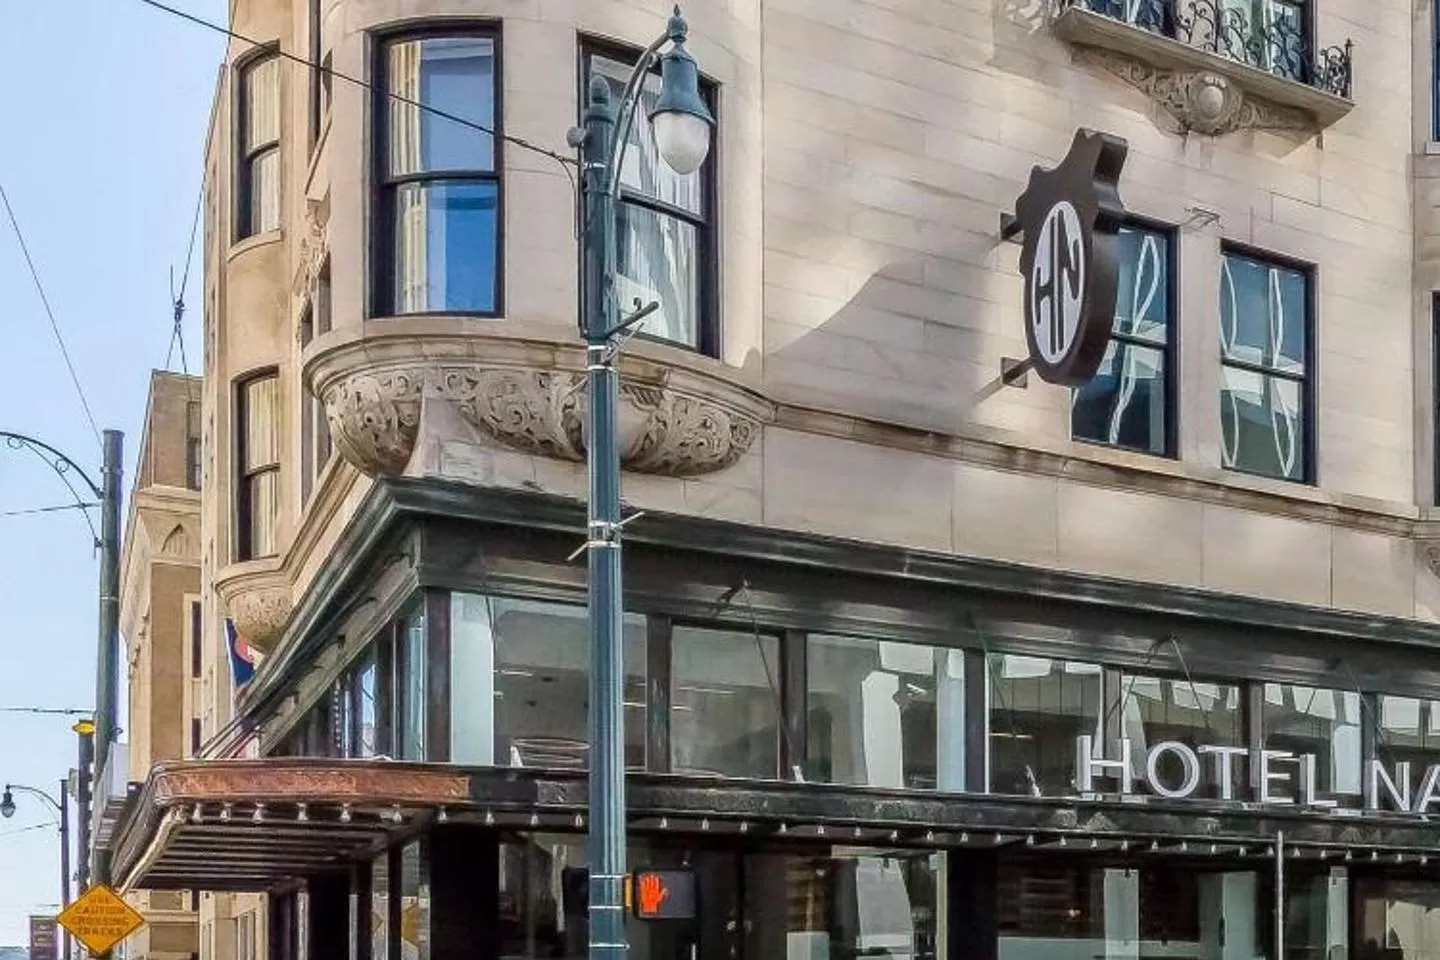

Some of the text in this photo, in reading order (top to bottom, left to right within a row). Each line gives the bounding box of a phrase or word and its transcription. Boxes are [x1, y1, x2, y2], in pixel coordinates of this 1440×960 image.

[1076, 735, 1338, 807] HOTEL
[75, 905, 126, 914] CAUTION
[70, 916, 130, 926] CROSSING
[76, 927, 123, 936] TRACKS
